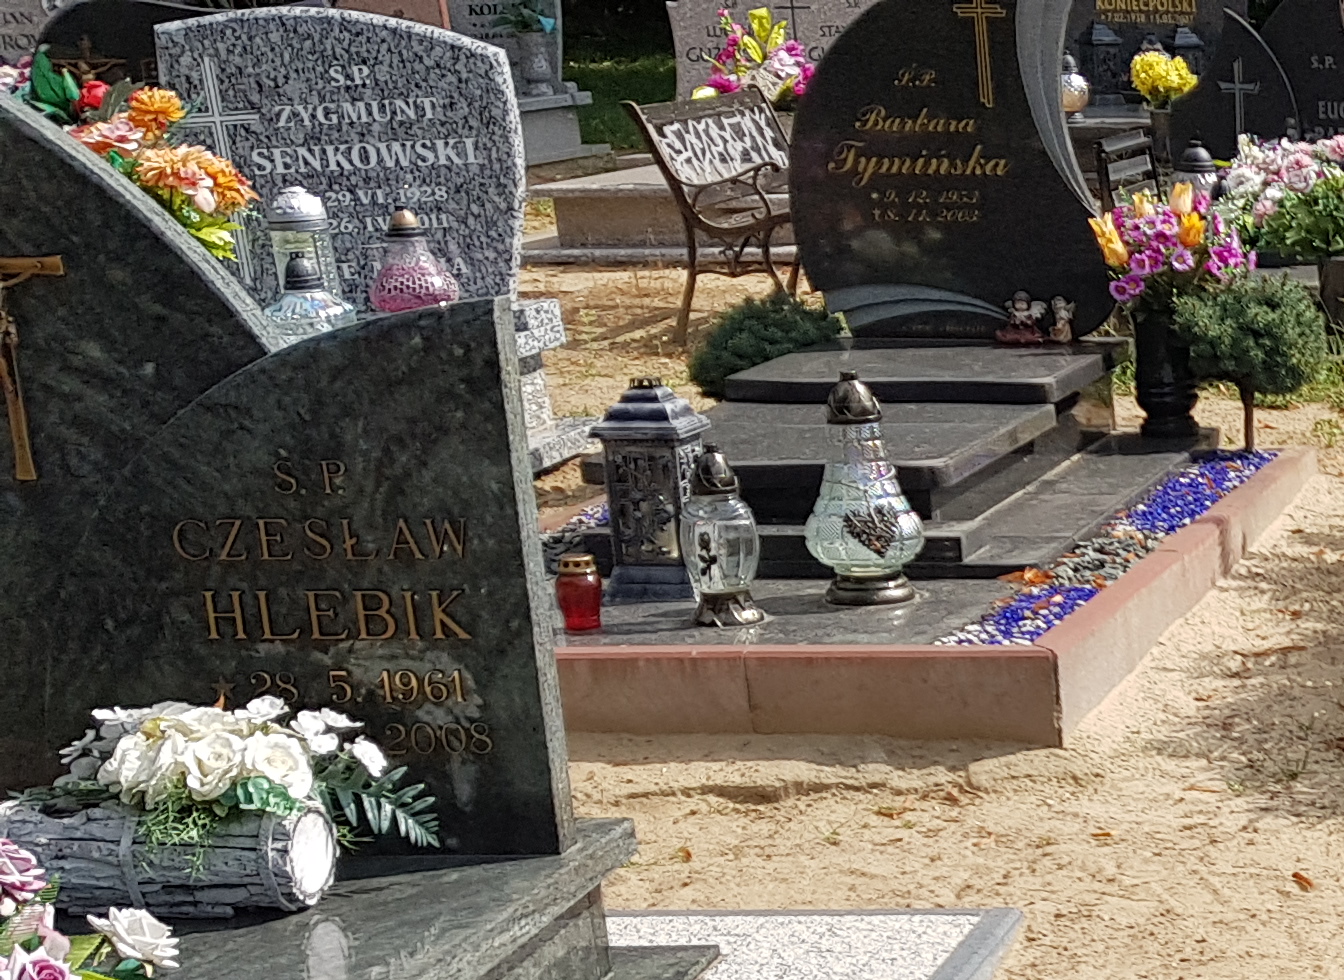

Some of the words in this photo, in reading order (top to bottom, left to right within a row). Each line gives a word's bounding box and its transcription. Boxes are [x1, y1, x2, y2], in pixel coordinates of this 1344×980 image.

[274, 97, 437, 128] ZYGMUNT
[855, 104, 978, 133] Barbara
[252, 137, 480, 175] SENKOWSKI
[827, 140, 1011, 188] Tymińska
[172, 517, 467, 562] CZESŁAW
[201, 589, 473, 641] HLEBIK
[376, 668, 467, 704] 1961
[385, 722, 494, 756] 2008
